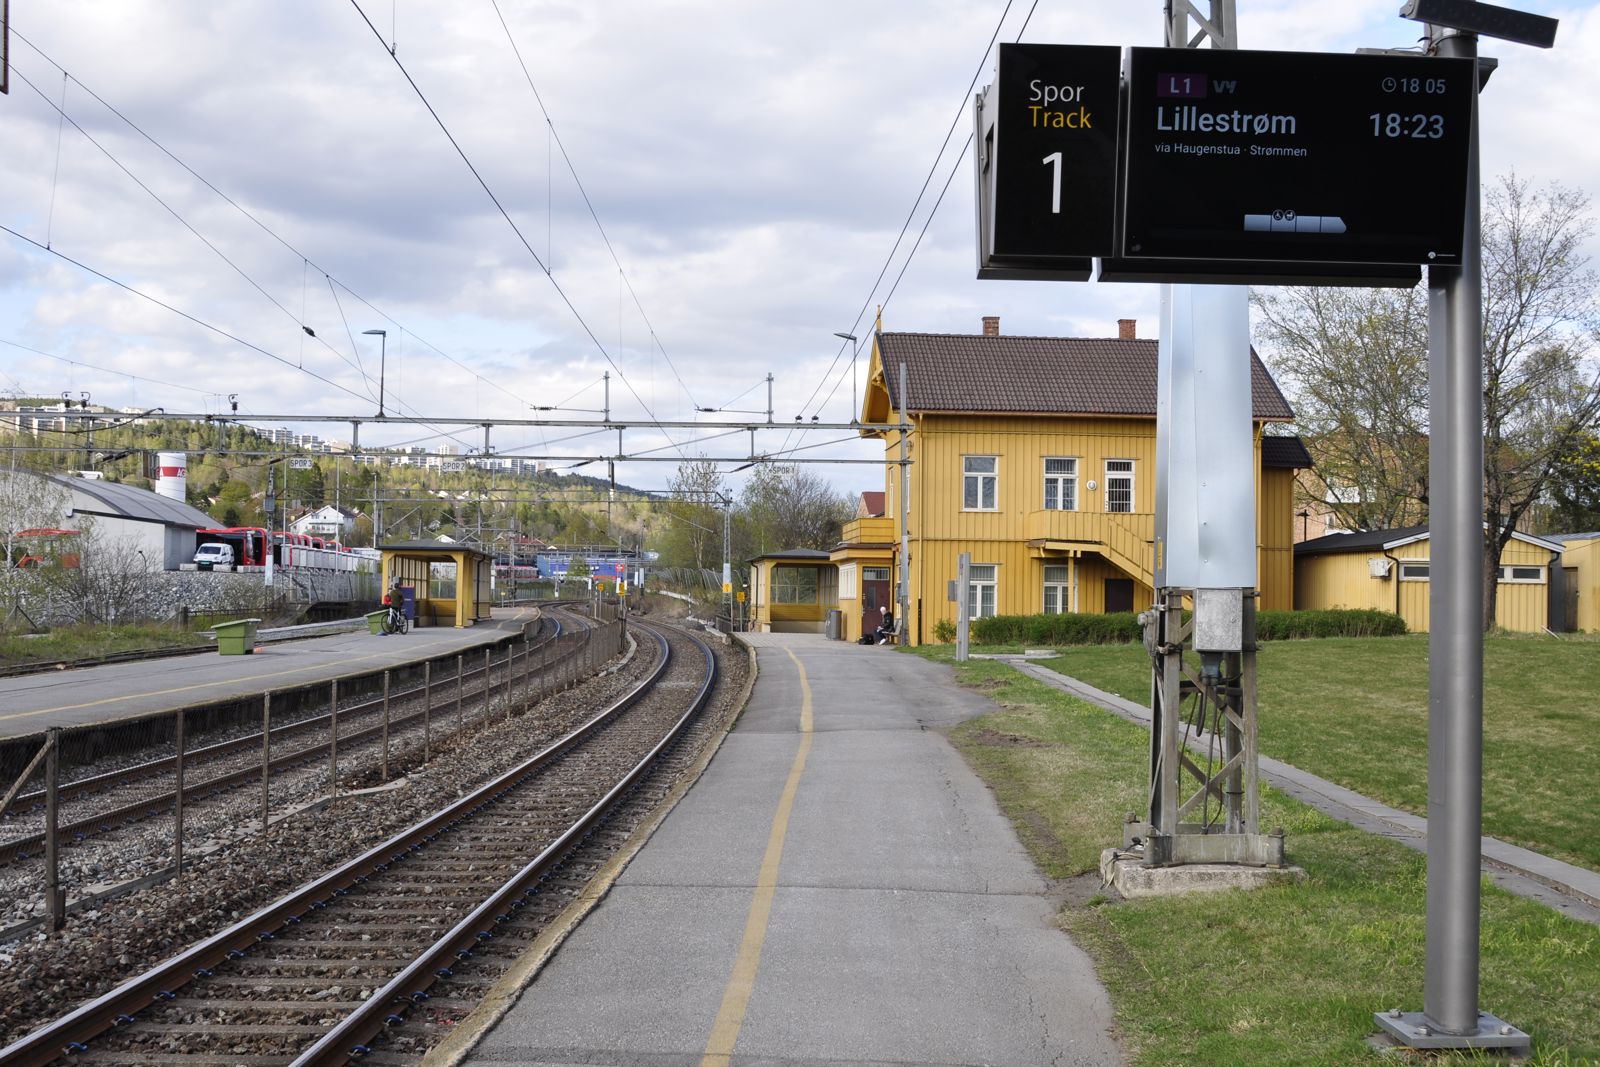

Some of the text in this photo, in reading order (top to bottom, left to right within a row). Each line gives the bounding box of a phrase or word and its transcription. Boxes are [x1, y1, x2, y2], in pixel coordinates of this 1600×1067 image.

[1029, 79, 1085, 107] Spor
[1170, 77, 1191, 94] L1
[1028, 106, 1092, 129] Track
[1157, 106, 1297, 135] Lillestrøm
[1370, 113, 1444, 139] 18:23
[1155, 142, 1307, 157] via Haugenstua Strømmen
[1042, 151, 1063, 214] 1
[442, 462, 460, 470] SPOR
[772, 466, 789, 474] SPOR
